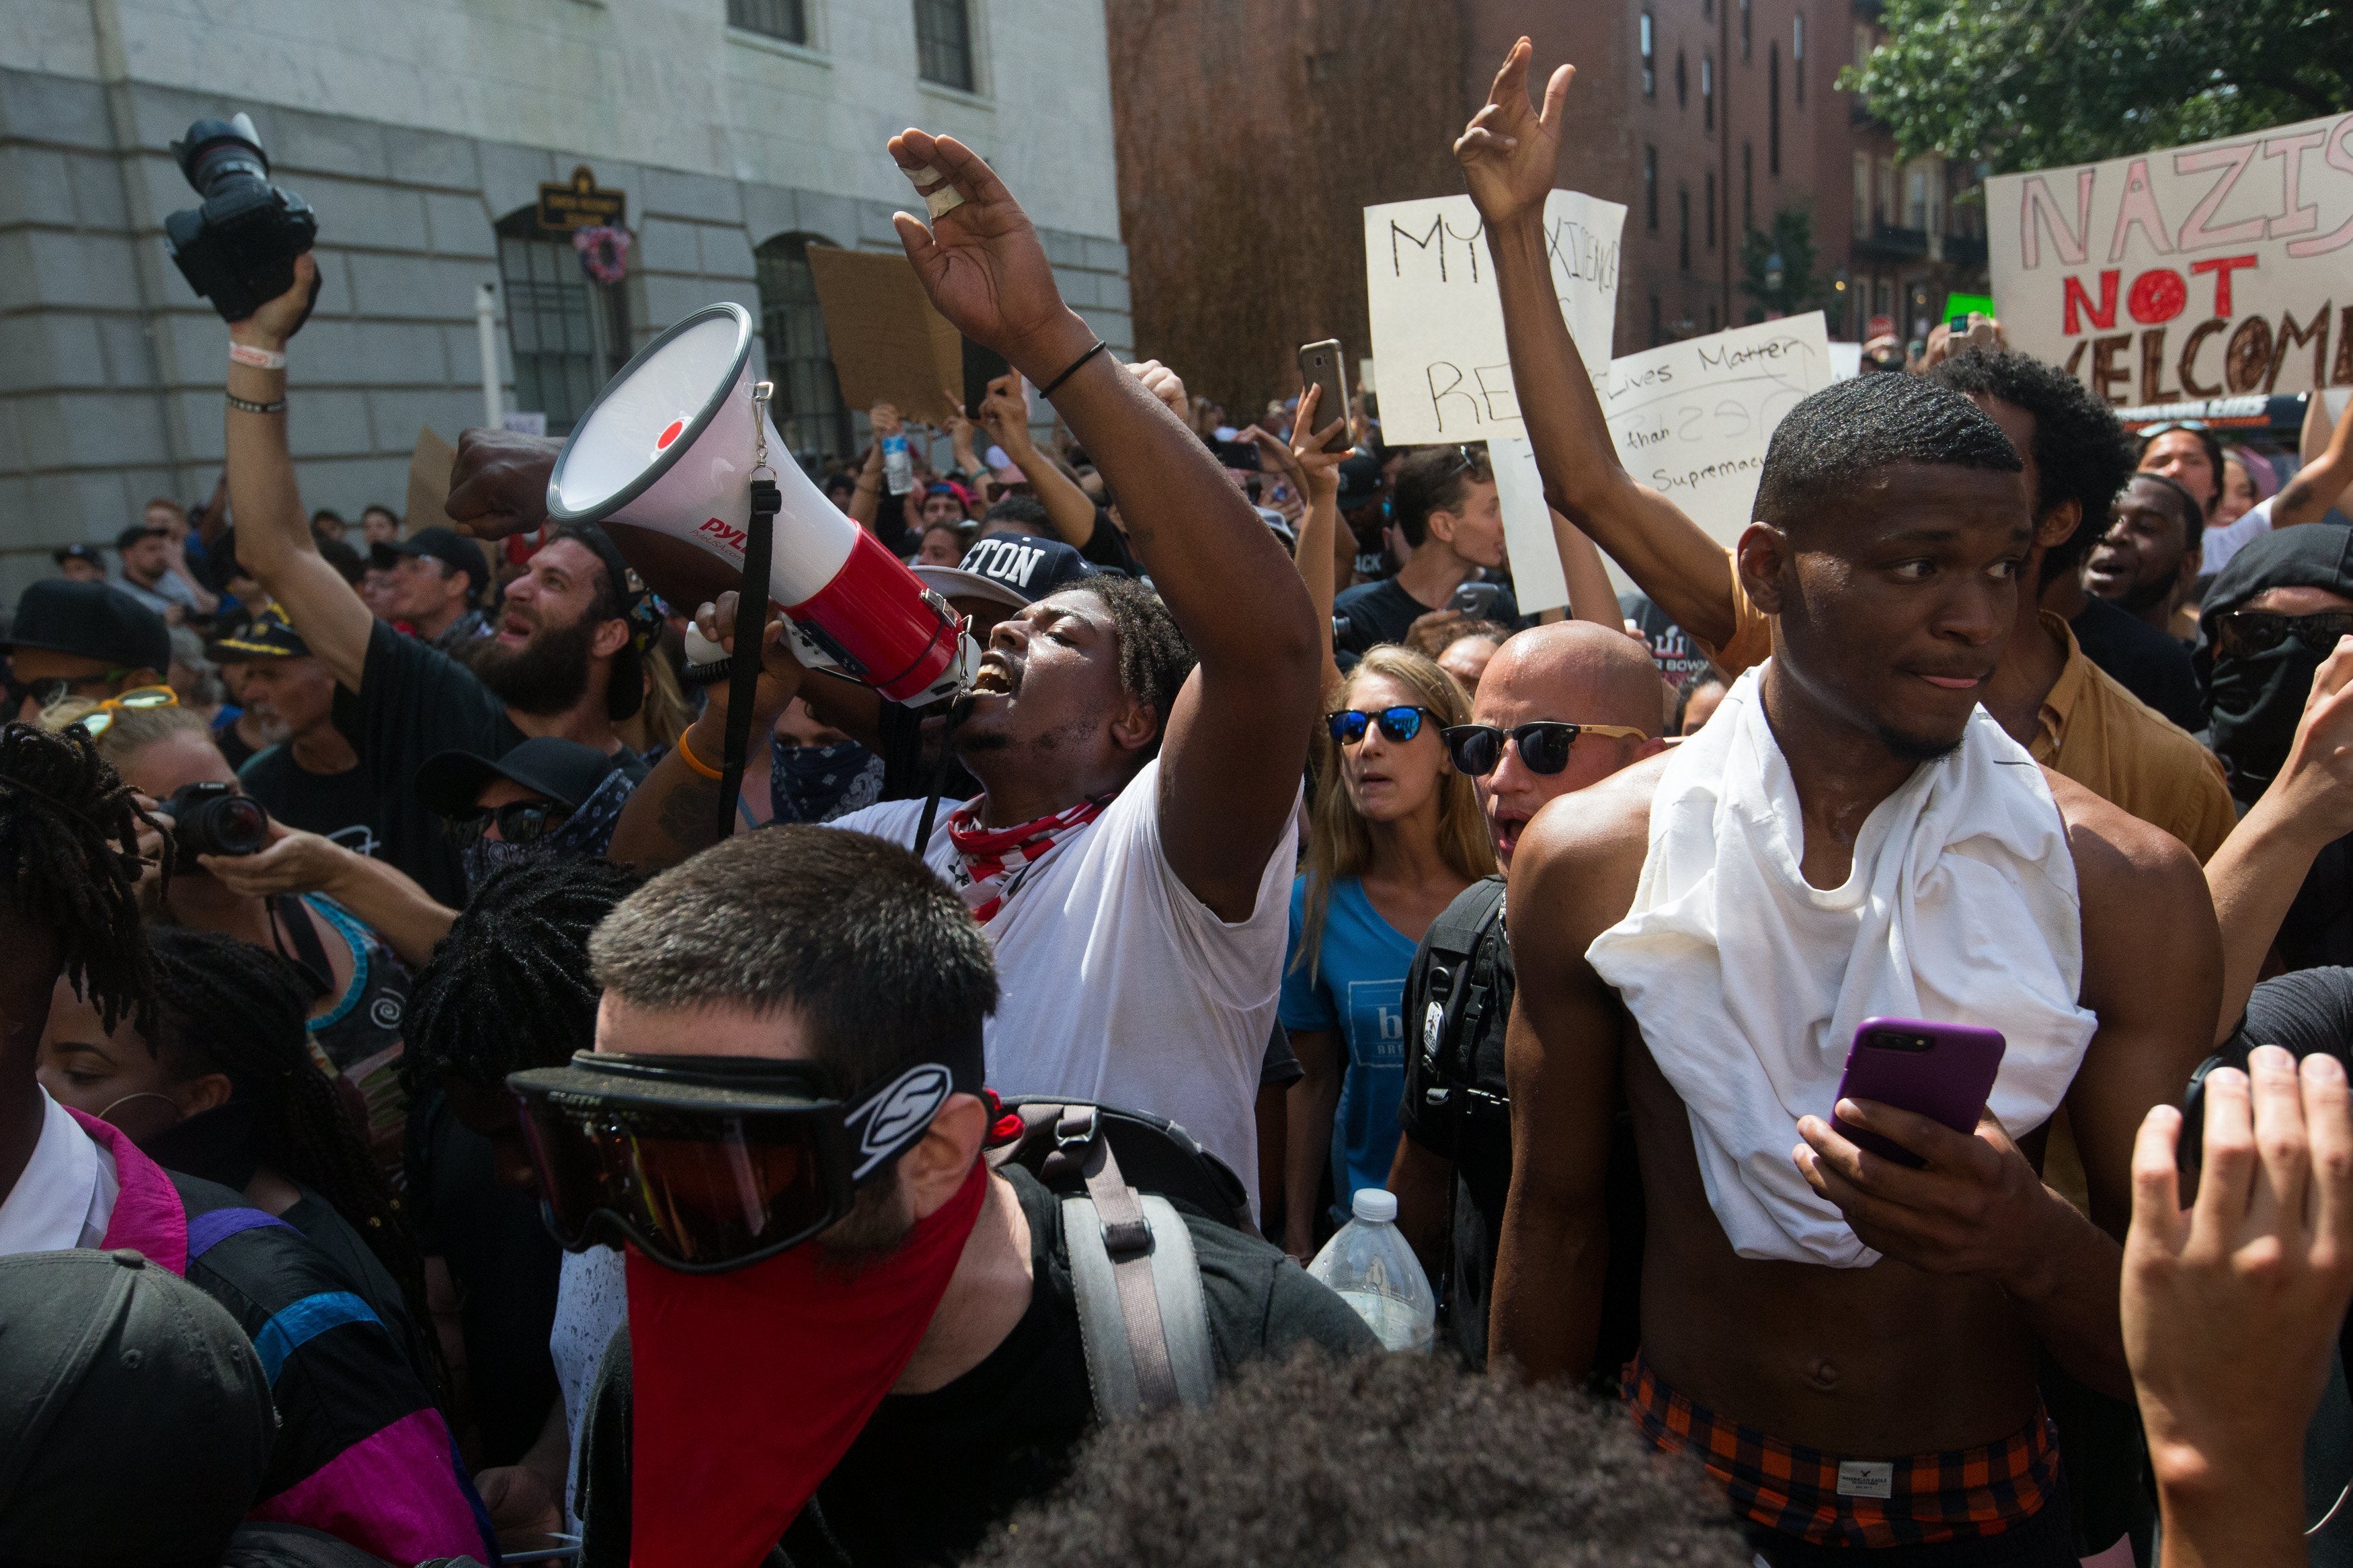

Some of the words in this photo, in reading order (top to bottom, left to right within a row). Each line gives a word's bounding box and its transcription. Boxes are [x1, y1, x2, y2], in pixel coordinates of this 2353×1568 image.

[1390, 213, 1482, 283] MY
[2063, 254, 2258, 335] NOT
[1697, 339, 1800, 371] Matter
[2065, 298, 2353, 406] ELCOM
[1625, 428, 1669, 449] than
[1652, 456, 1765, 492] Supremac
[689, 530, 744, 562] PyleUSA.com
